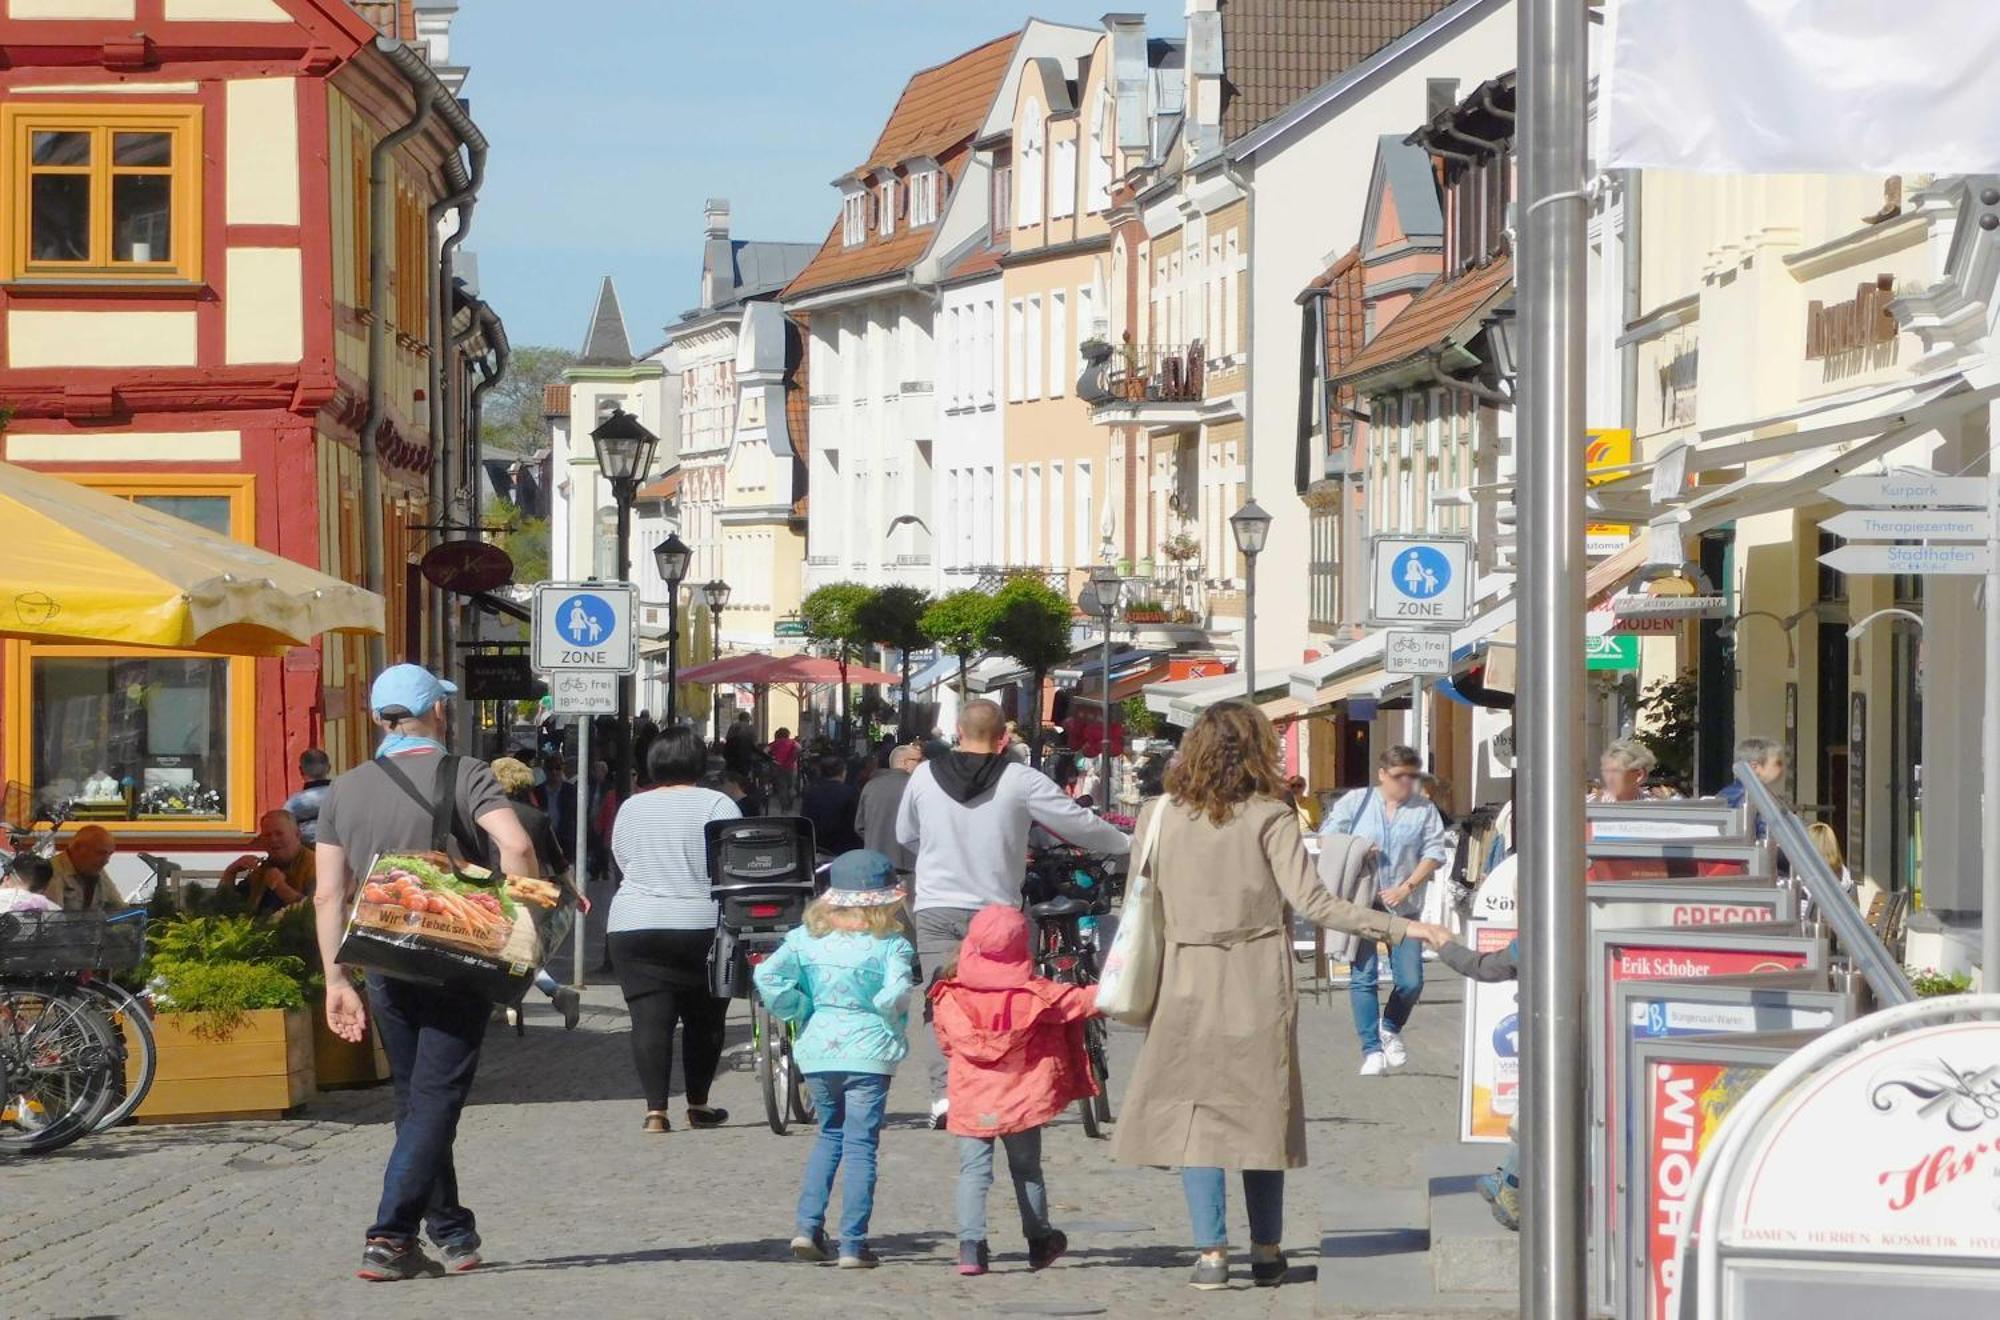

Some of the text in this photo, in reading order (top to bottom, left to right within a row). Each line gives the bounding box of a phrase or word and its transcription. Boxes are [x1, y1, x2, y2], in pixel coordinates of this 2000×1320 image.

[1881, 484, 1938, 498] Kurpark
[1864, 519, 1974, 534] Therapiezentren
[1888, 547, 1974, 562] Stadthafen
[1397, 602, 1443, 616] ZONE
[1424, 640, 1445, 650] frei
[560, 651, 607, 664] ZONE
[591, 680, 612, 689] frei
[379, 909, 401, 926] Wir
[1621, 957, 1711, 977] Erik Schober
[1742, 1228, 1797, 1242] DAMEN
[1807, 1230, 1872, 1244] HERREN
[1880, 1232, 1958, 1248] KOSMETIK
